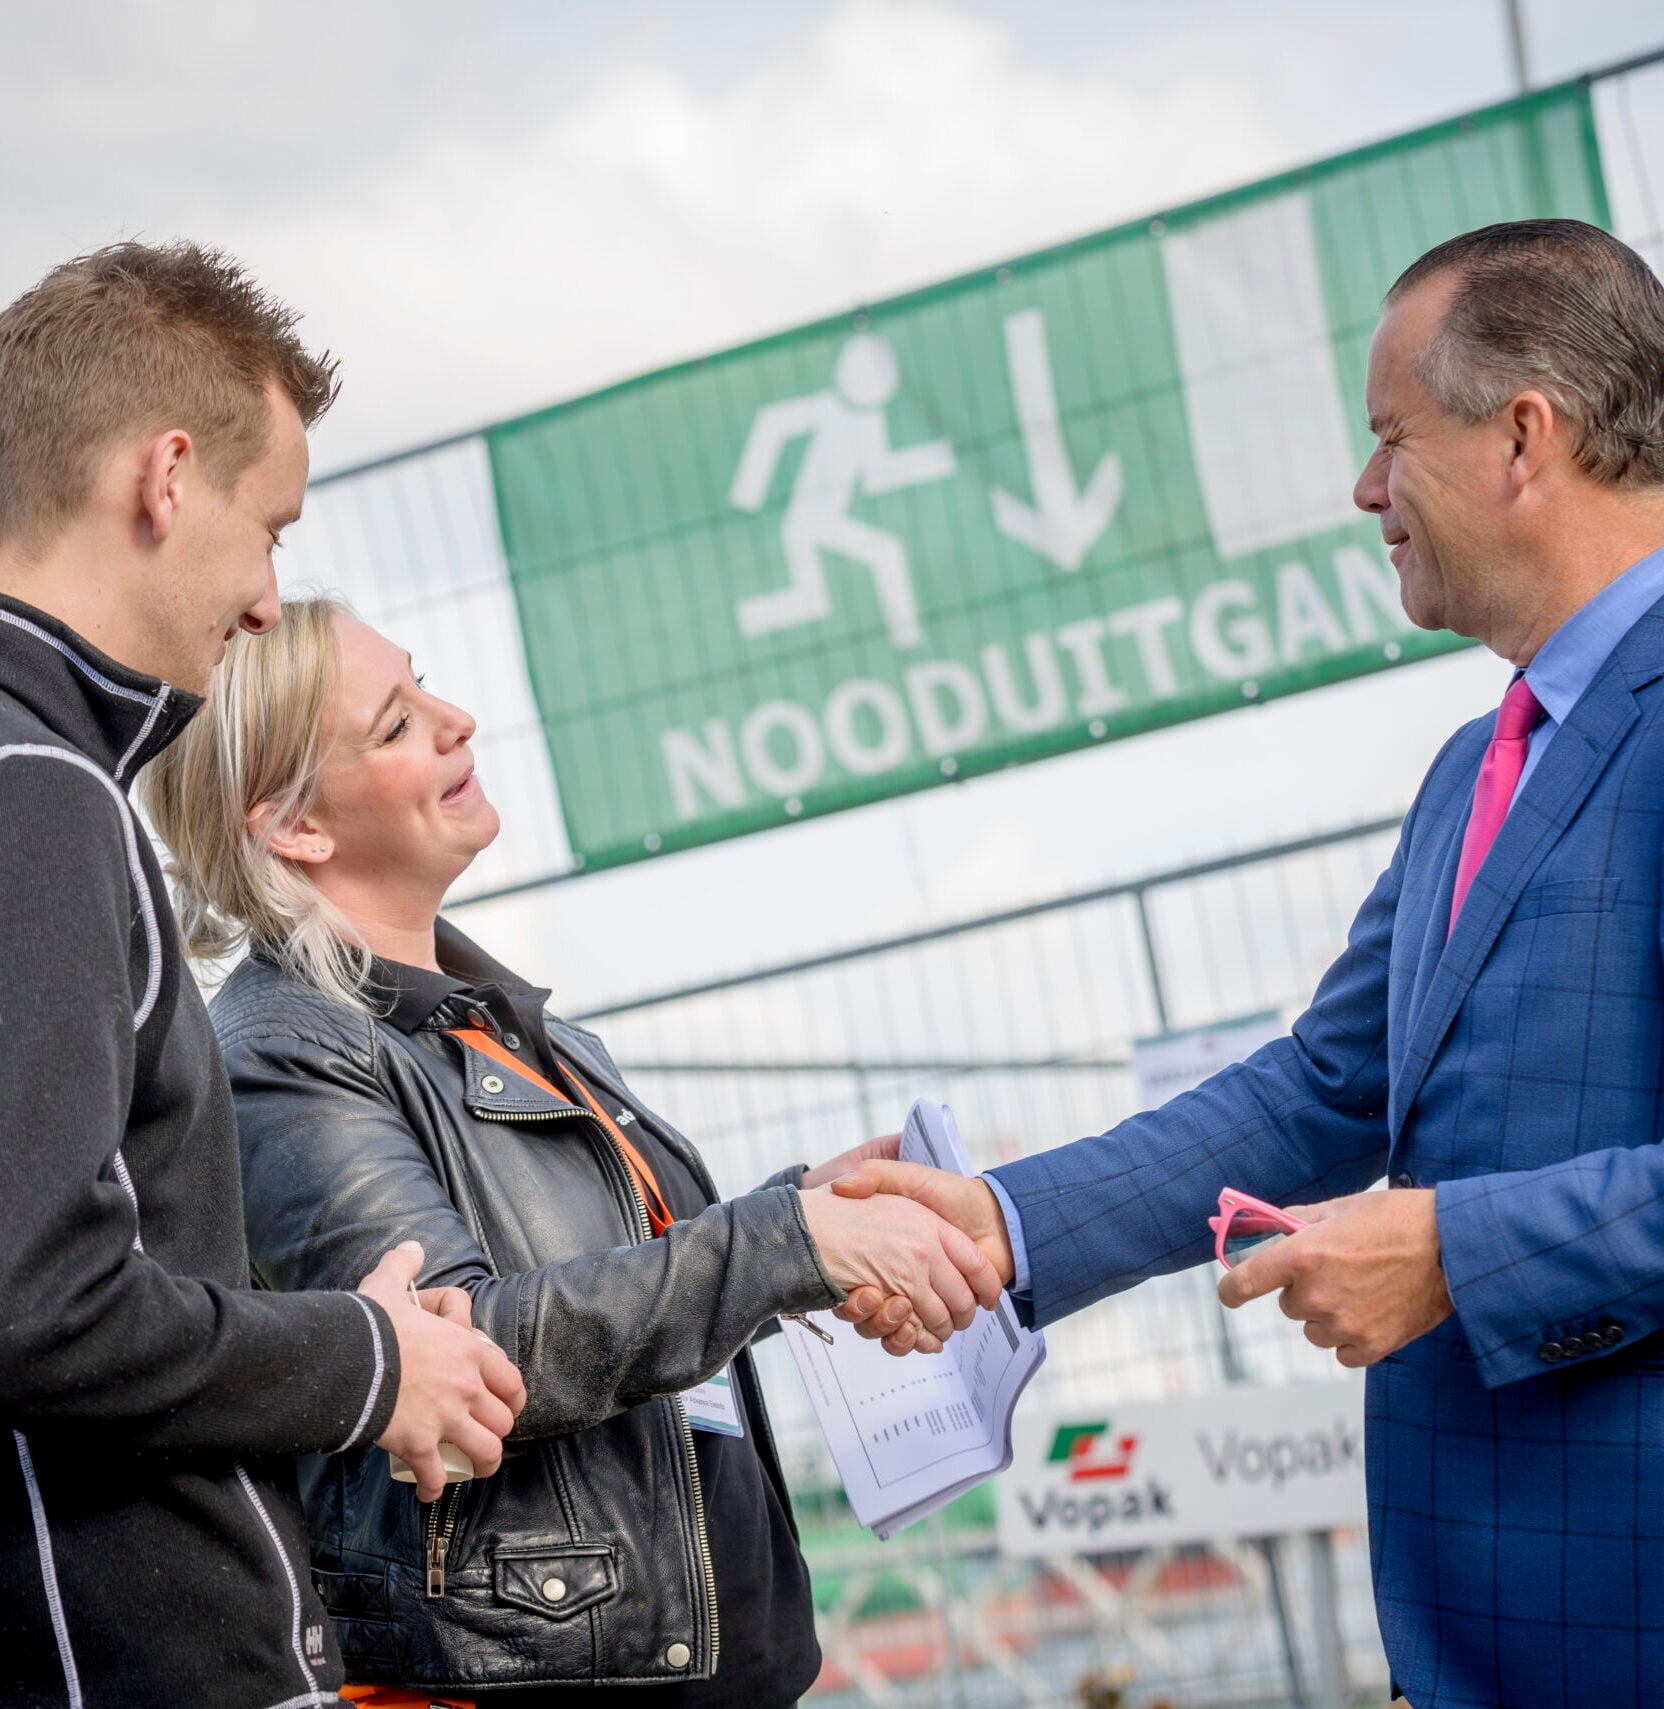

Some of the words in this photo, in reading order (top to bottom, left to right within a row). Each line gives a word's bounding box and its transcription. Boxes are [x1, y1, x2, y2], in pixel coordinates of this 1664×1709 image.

[661, 546, 1412, 820] NOODUITGAN
[1196, 1415, 1363, 1491] Vopak
[1018, 1478, 1174, 1532] Vopak
